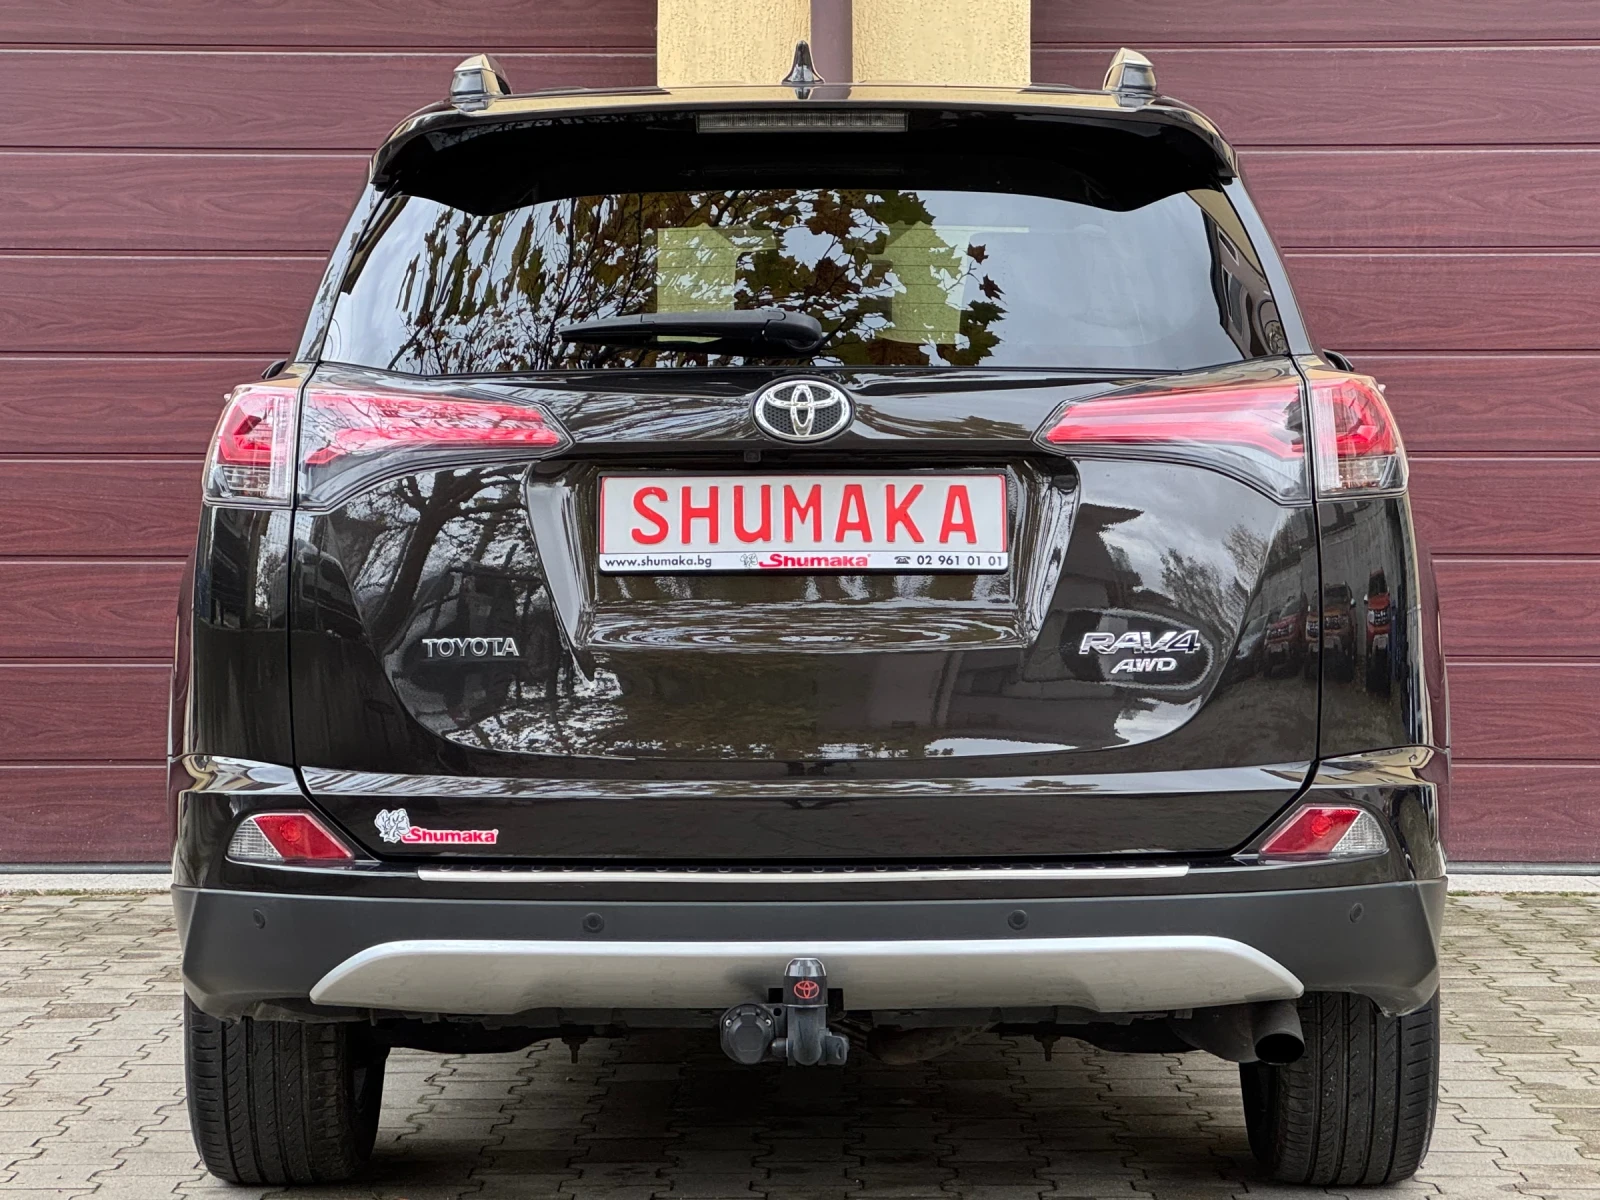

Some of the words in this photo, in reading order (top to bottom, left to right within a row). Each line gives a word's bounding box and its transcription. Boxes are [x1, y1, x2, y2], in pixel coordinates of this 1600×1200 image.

[631, 484, 978, 544] SHUMAKA
[605, 555, 712, 568] www.shumaka.bg
[758, 553, 869, 568] Shumaka
[917, 555, 933, 566] 02
[938, 555, 960, 566] 961
[967, 556, 981, 566] 01
[988, 556, 1002, 567] 01
[422, 637, 520, 658] TOYOTA
[1078, 629, 1201, 655] RAV4
[1110, 657, 1178, 674] AWD
[402, 827, 496, 843] Shumaka
